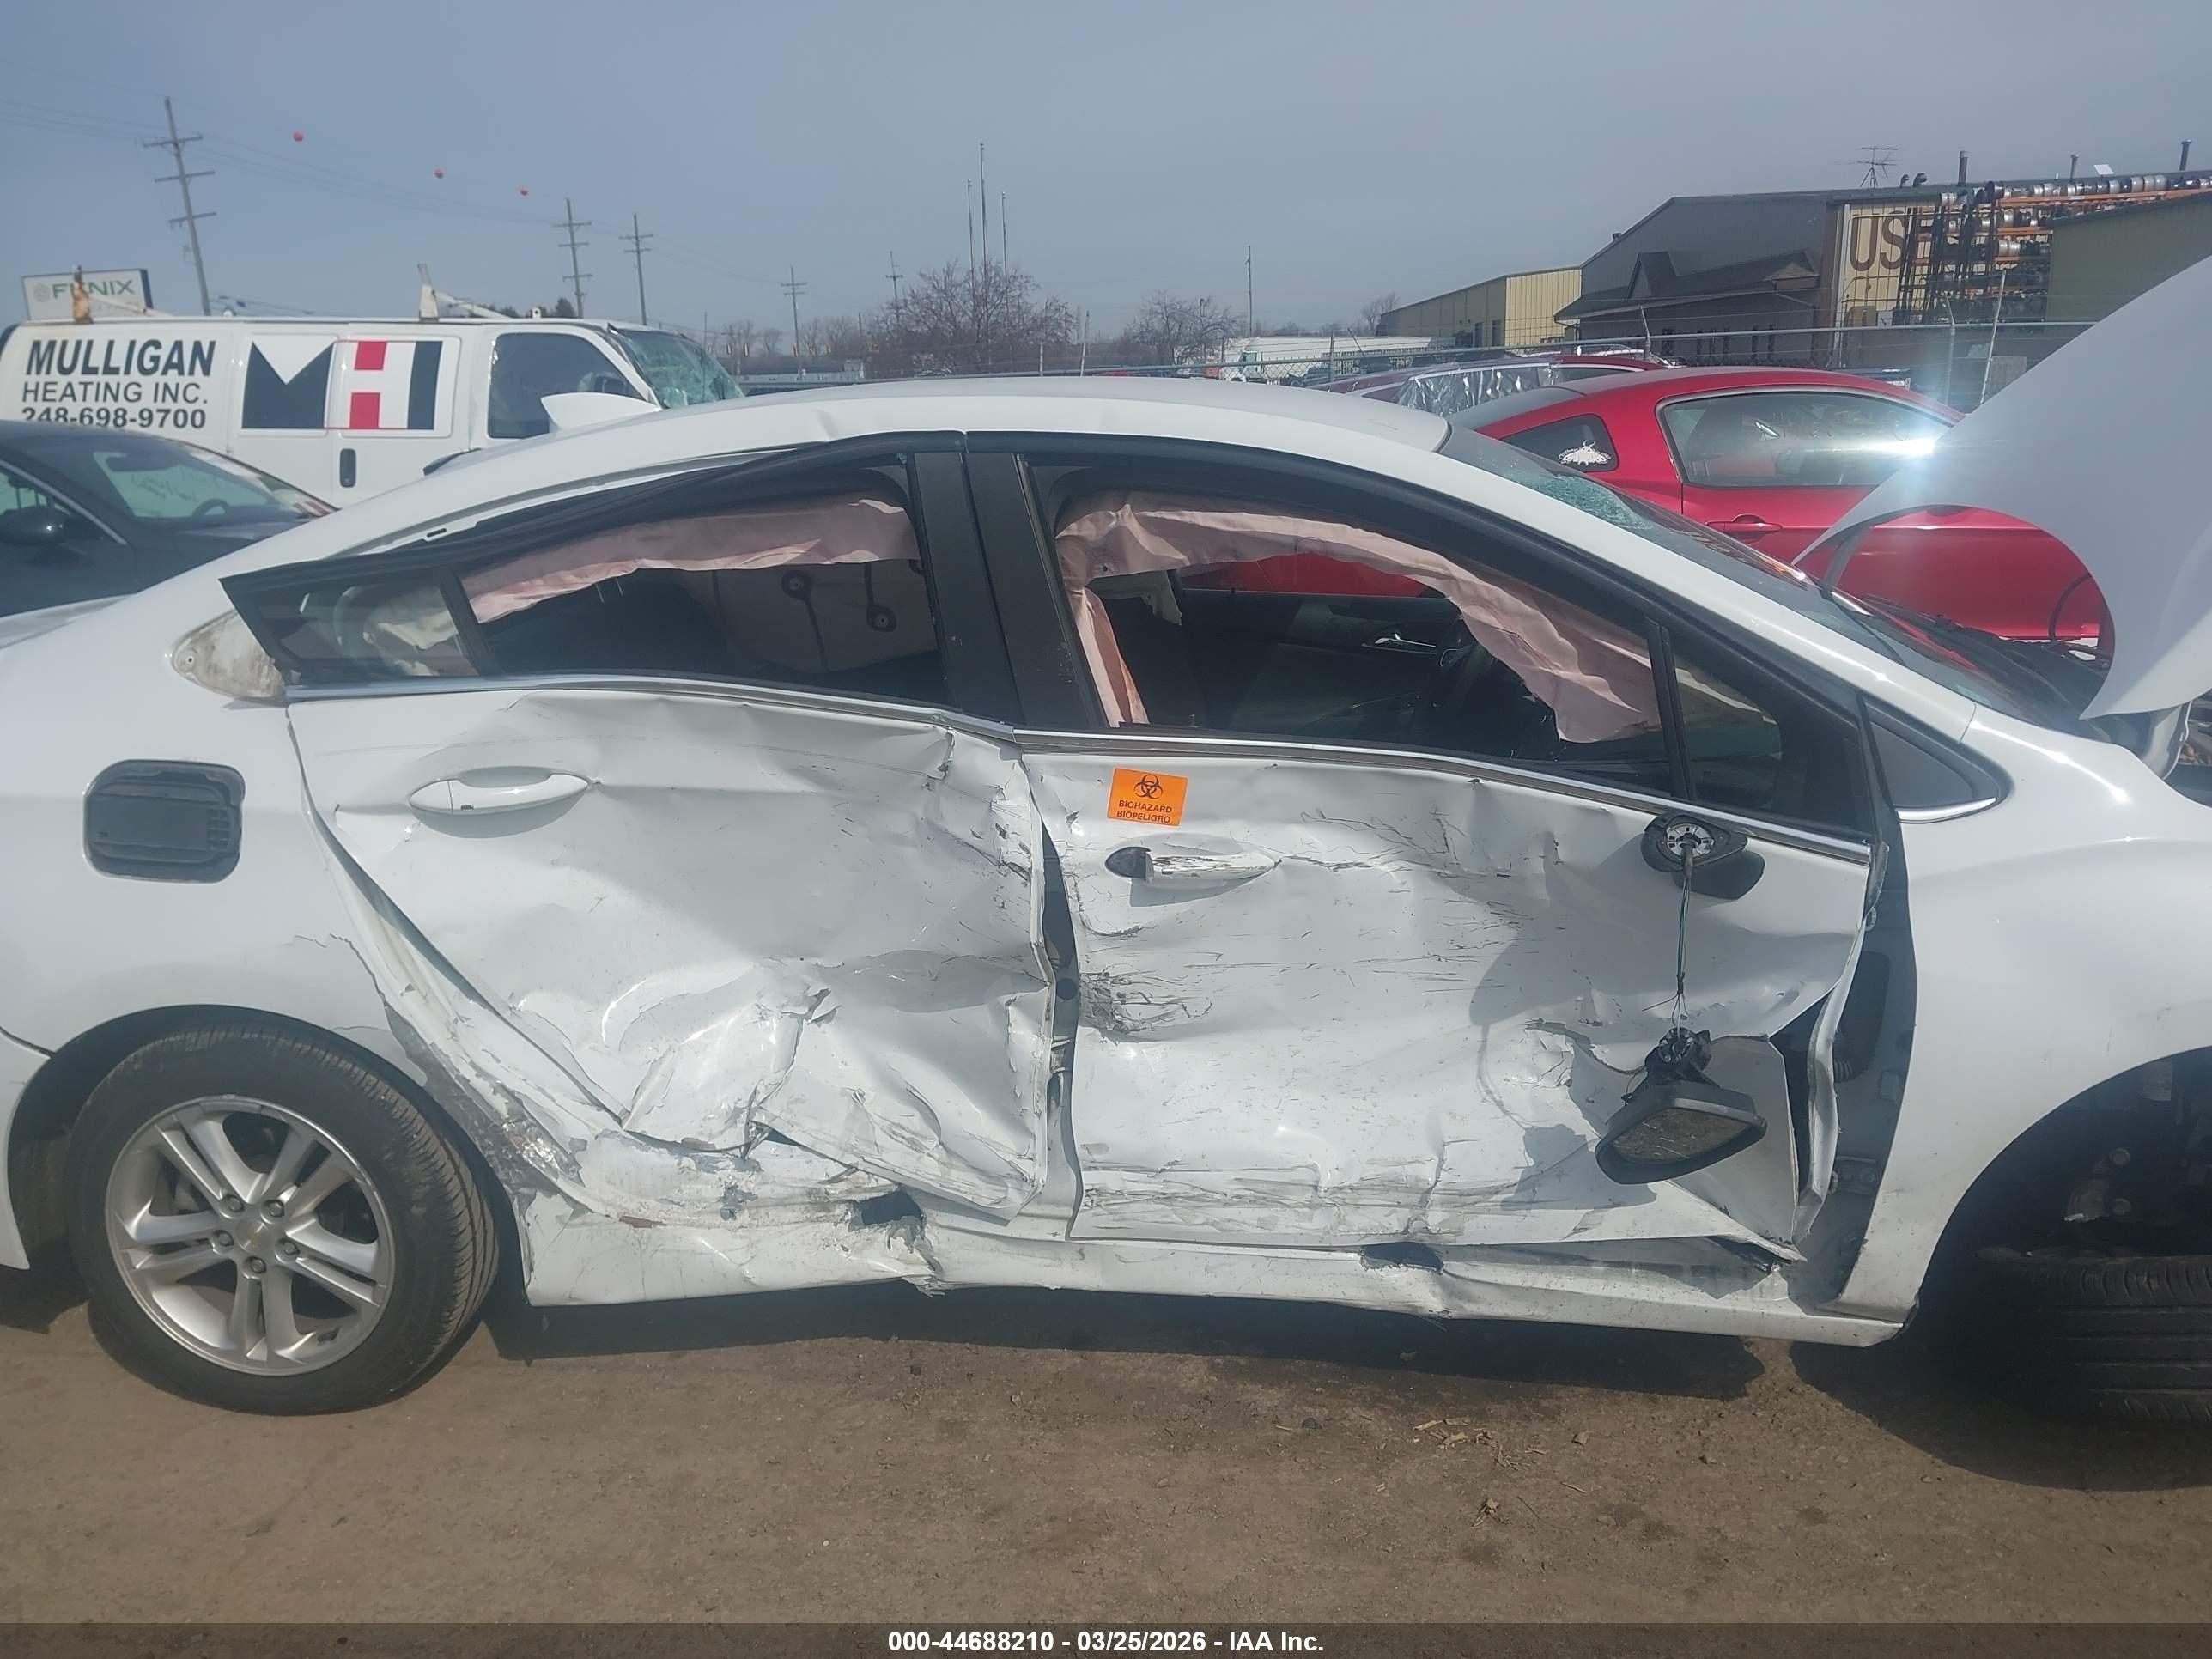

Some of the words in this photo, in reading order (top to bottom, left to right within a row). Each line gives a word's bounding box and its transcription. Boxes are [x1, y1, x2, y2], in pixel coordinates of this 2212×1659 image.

[52, 279, 135, 299] FNIX
[26, 339, 216, 376] MULLIGAN
[21, 381, 142, 403] HEATING
[153, 383, 208, 404] INC.
[21, 407, 206, 428] 248-698-9700
[1118, 799, 1173, 813] BIOHAZARD
[1116, 810, 1171, 823] BIOPELIGRO
